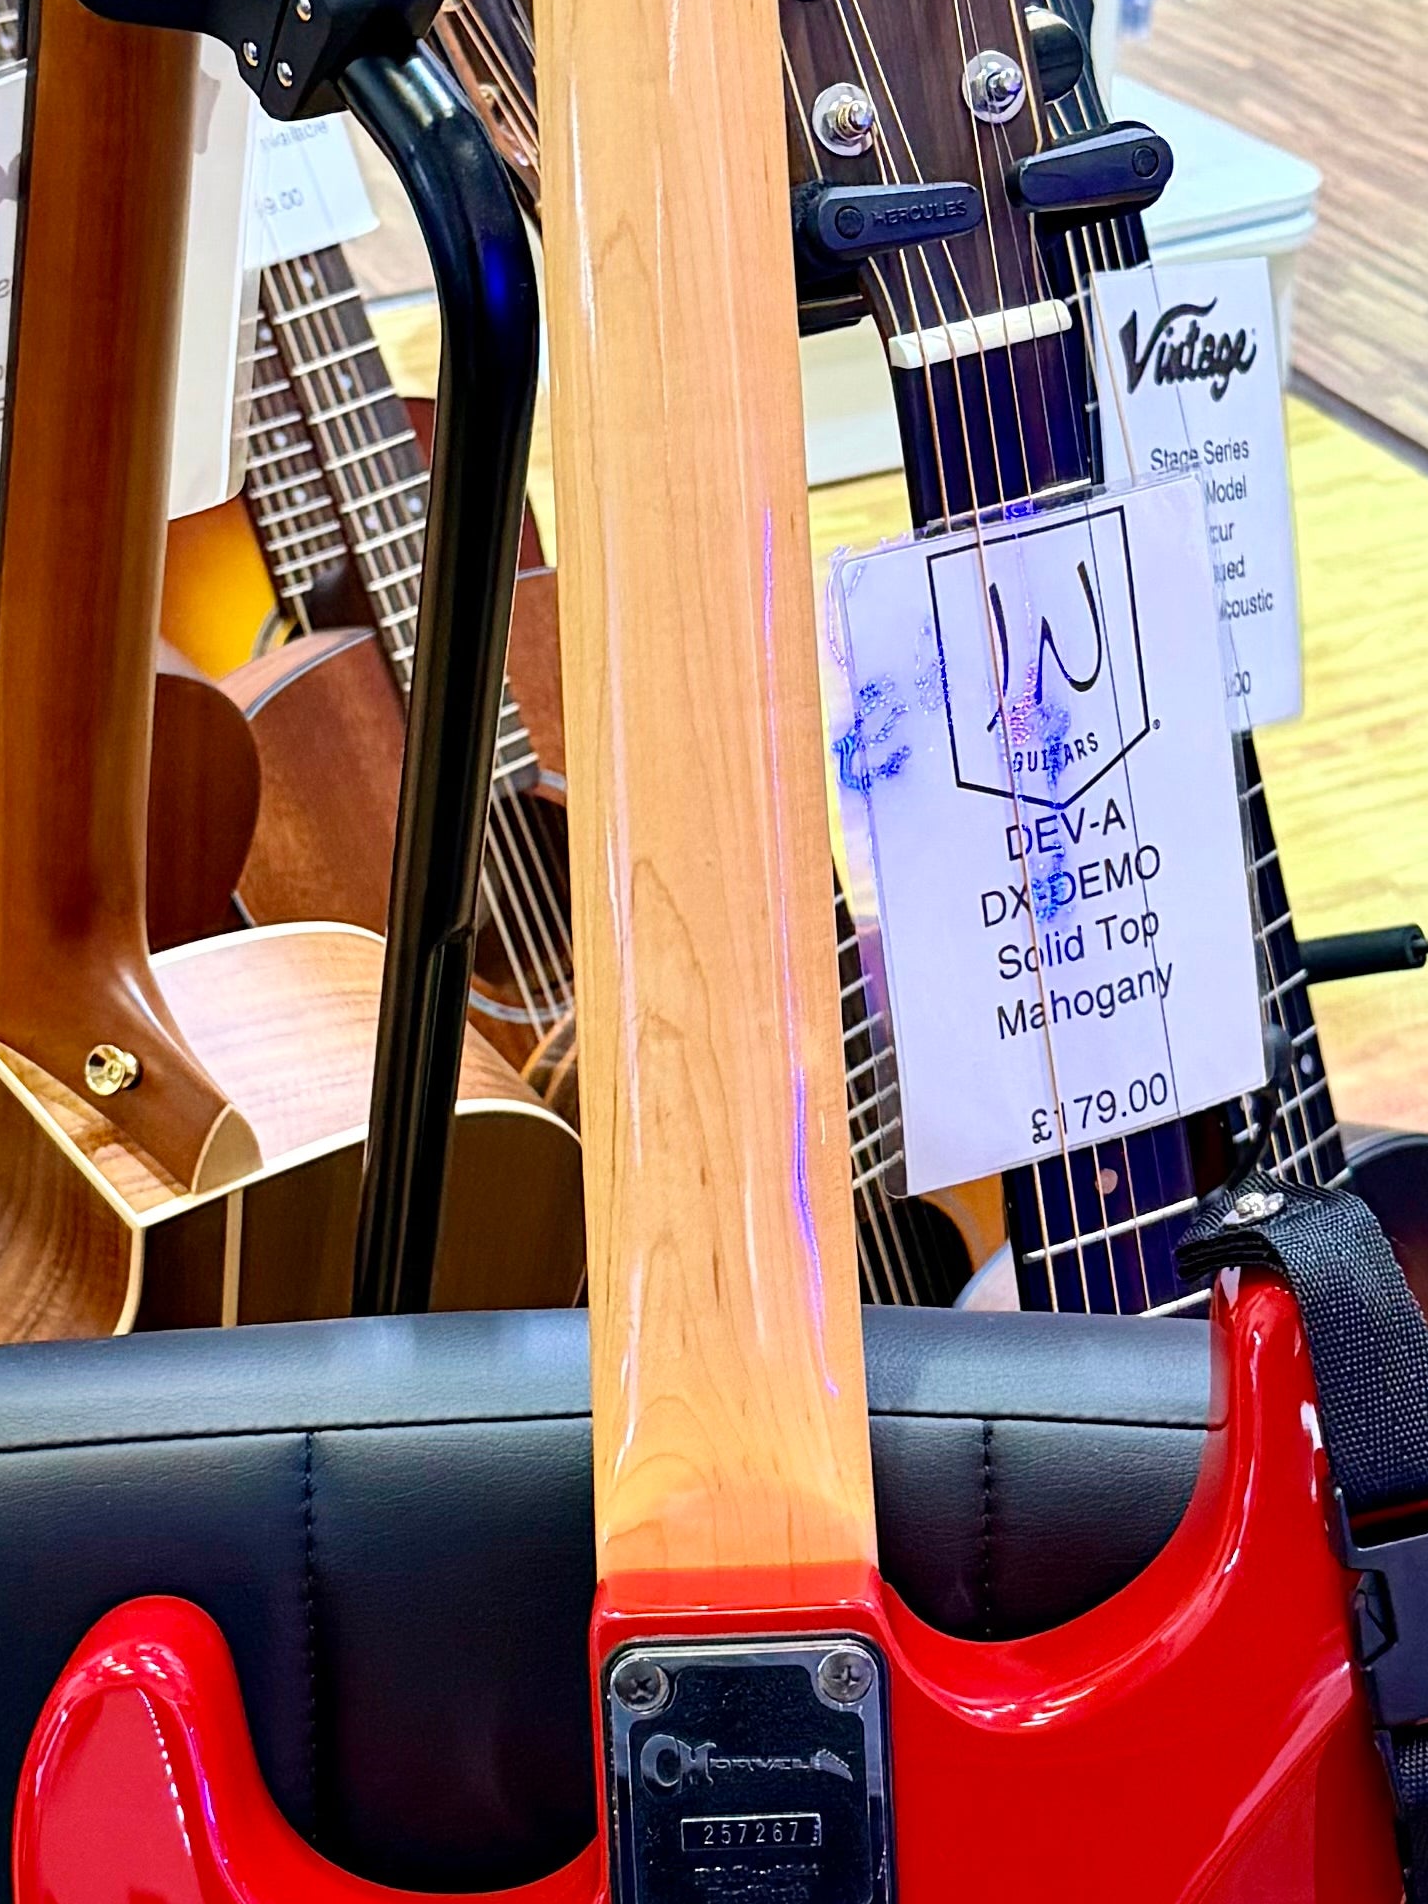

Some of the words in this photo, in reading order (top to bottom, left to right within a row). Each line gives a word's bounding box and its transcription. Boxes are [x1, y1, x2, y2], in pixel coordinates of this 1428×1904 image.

[872, 200, 968, 225] HERCULES
[1119, 297, 1257, 402] Vintage
[1203, 437, 1250, 466] Series
[1013, 732, 1099, 773] GUITARS
[1006, 798, 1125, 861] DEV-A
[981, 845, 1160, 927] DX-DEMO
[998, 925, 1085, 980] Solid
[1096, 911, 1159, 951] Top
[997, 963, 1172, 1039] Mahogany
[1032, 1072, 1168, 1143] £179.00
[703, 1821, 799, 1846] 257267
